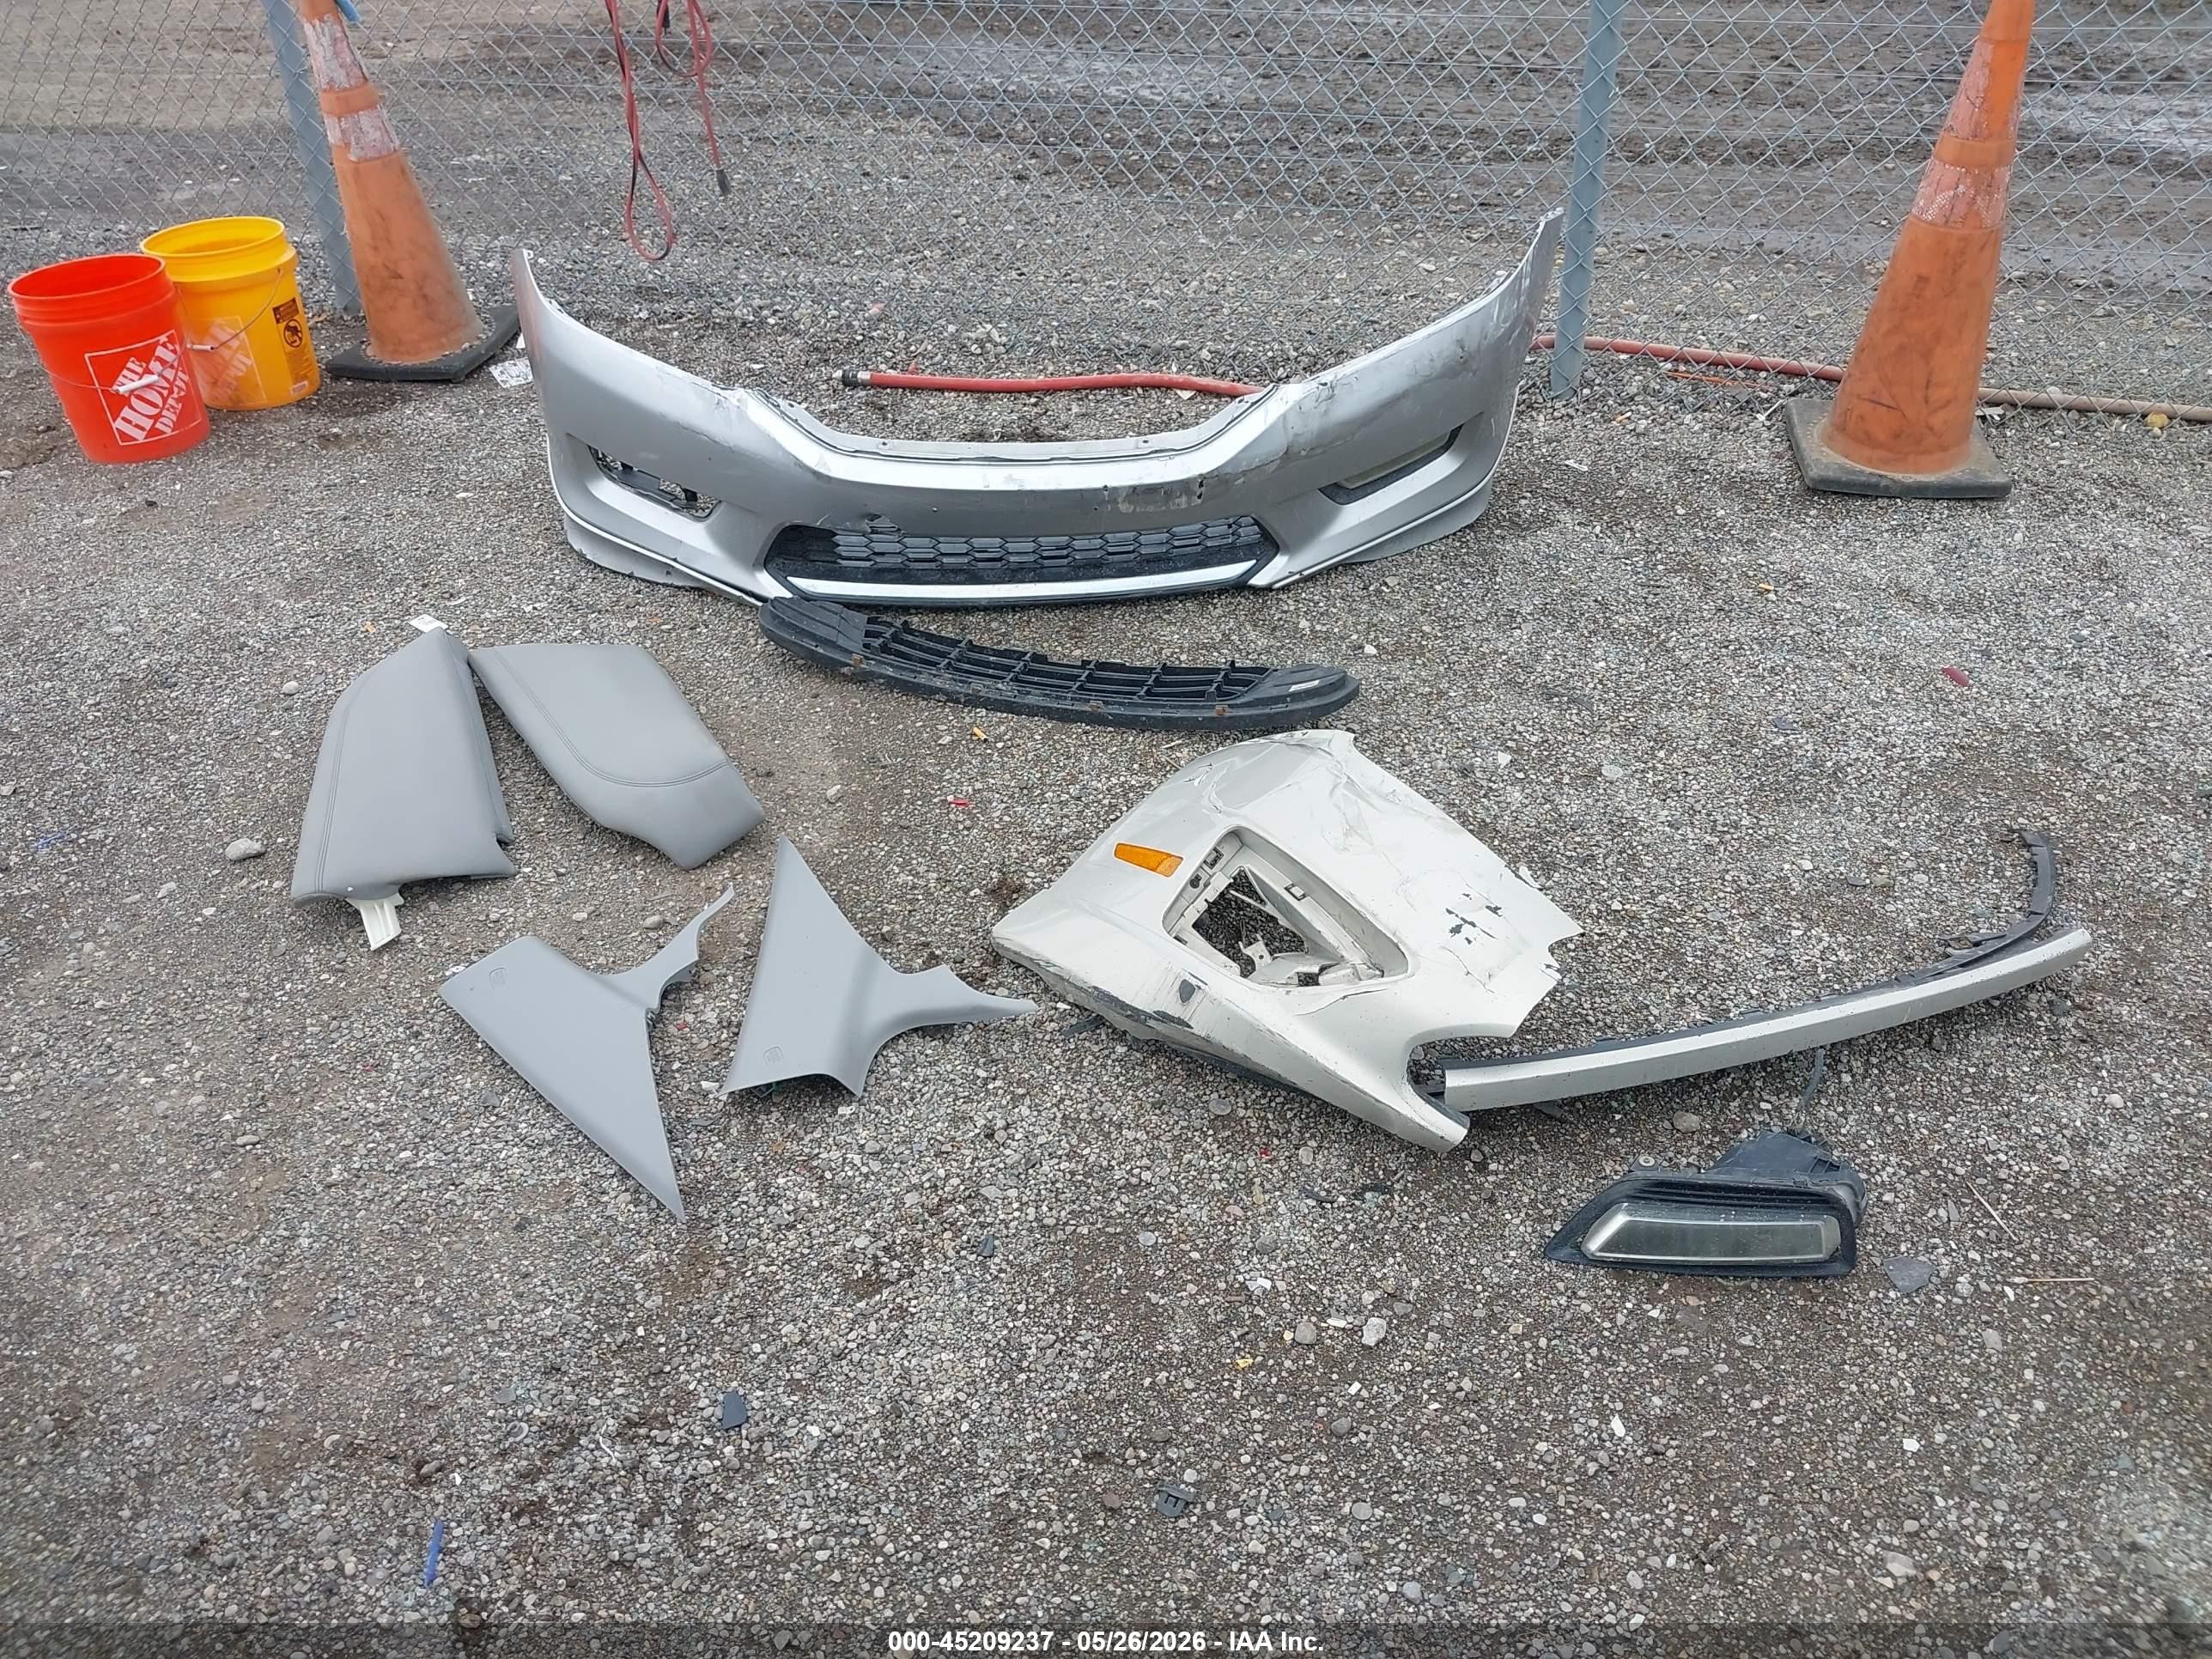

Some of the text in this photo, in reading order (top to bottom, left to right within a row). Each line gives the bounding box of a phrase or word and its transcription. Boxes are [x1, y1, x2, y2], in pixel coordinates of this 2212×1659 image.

[110, 357, 147, 397] THE
[114, 336, 179, 441] HOME
[155, 367, 189, 434] DEPOT
